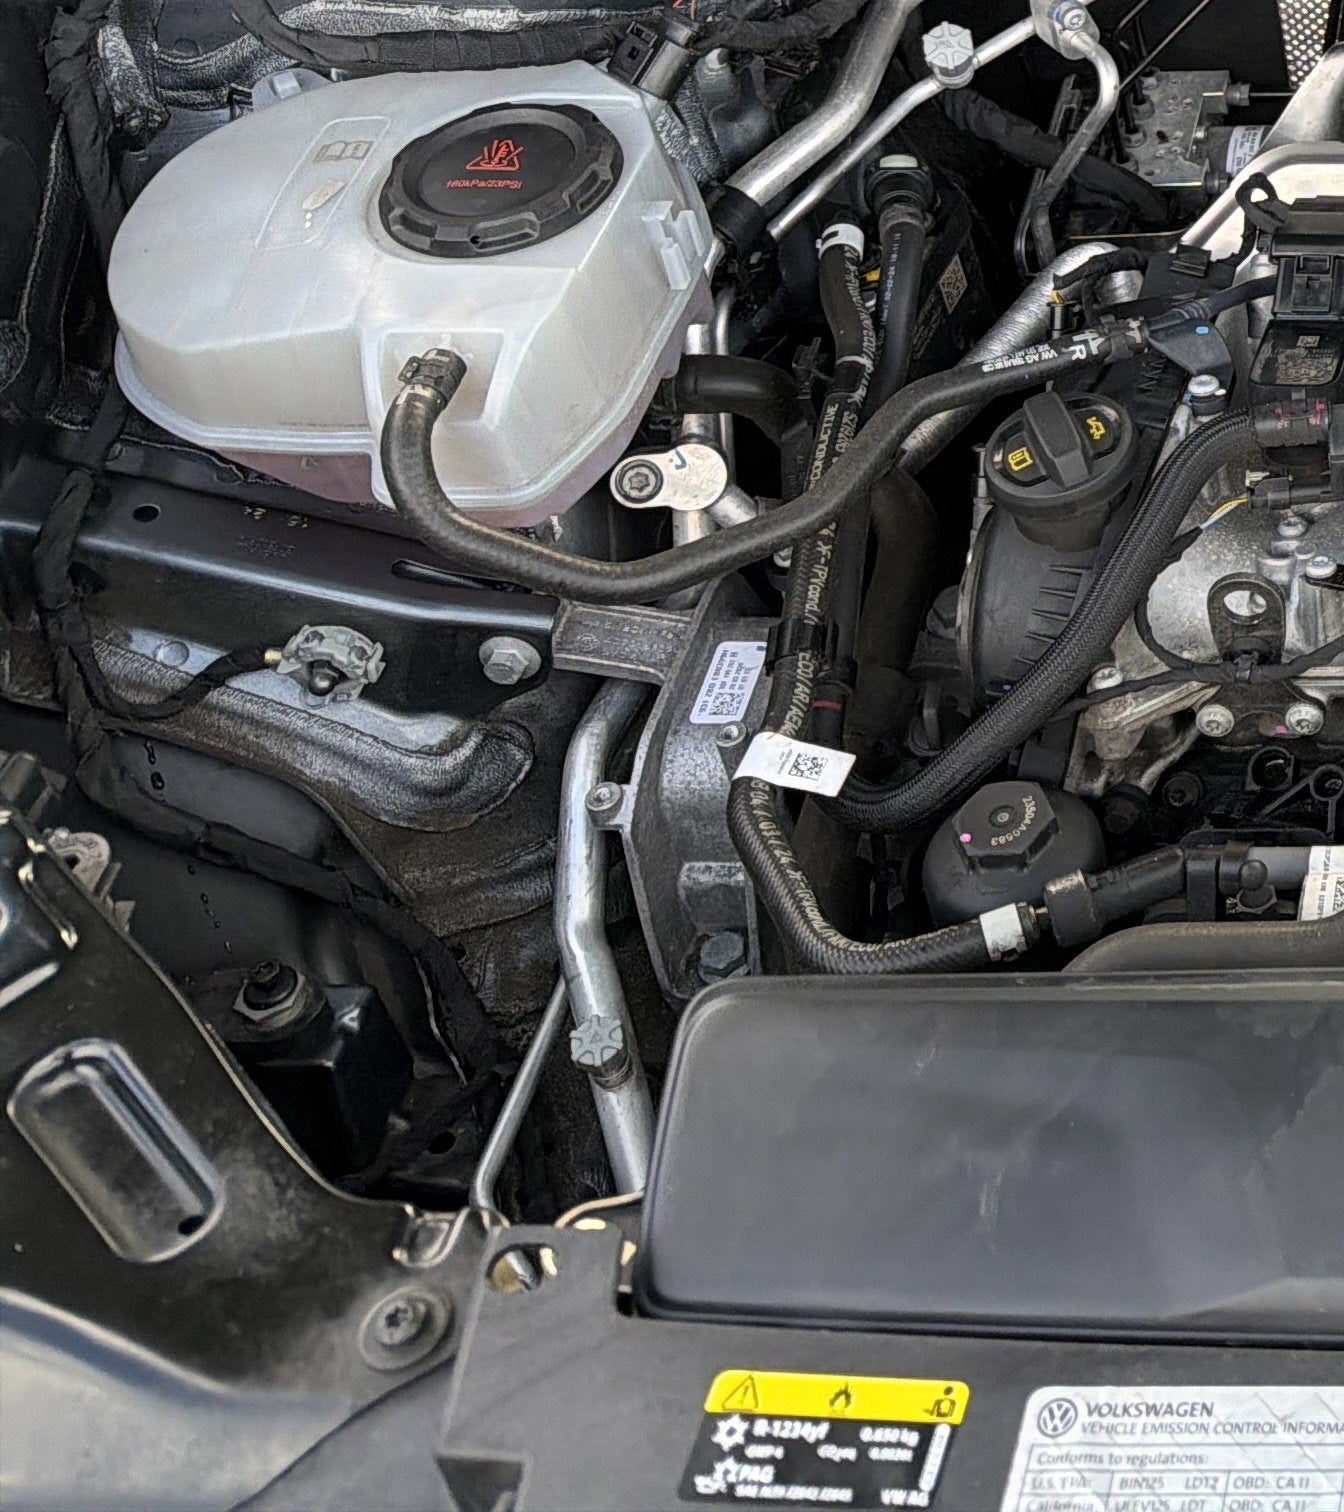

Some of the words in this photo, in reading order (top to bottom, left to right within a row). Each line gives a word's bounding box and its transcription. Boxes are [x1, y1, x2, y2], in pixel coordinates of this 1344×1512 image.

[1086, 1401, 1215, 1418] VOLKSWAGEN
[1081, 1421, 1138, 1434] VEHICLE
[1141, 1421, 1210, 1434] EMISSION
[1213, 1421, 1277, 1434] CONTROL
[1037, 1451, 1104, 1465] Conforms
[1108, 1452, 1123, 1464] to
